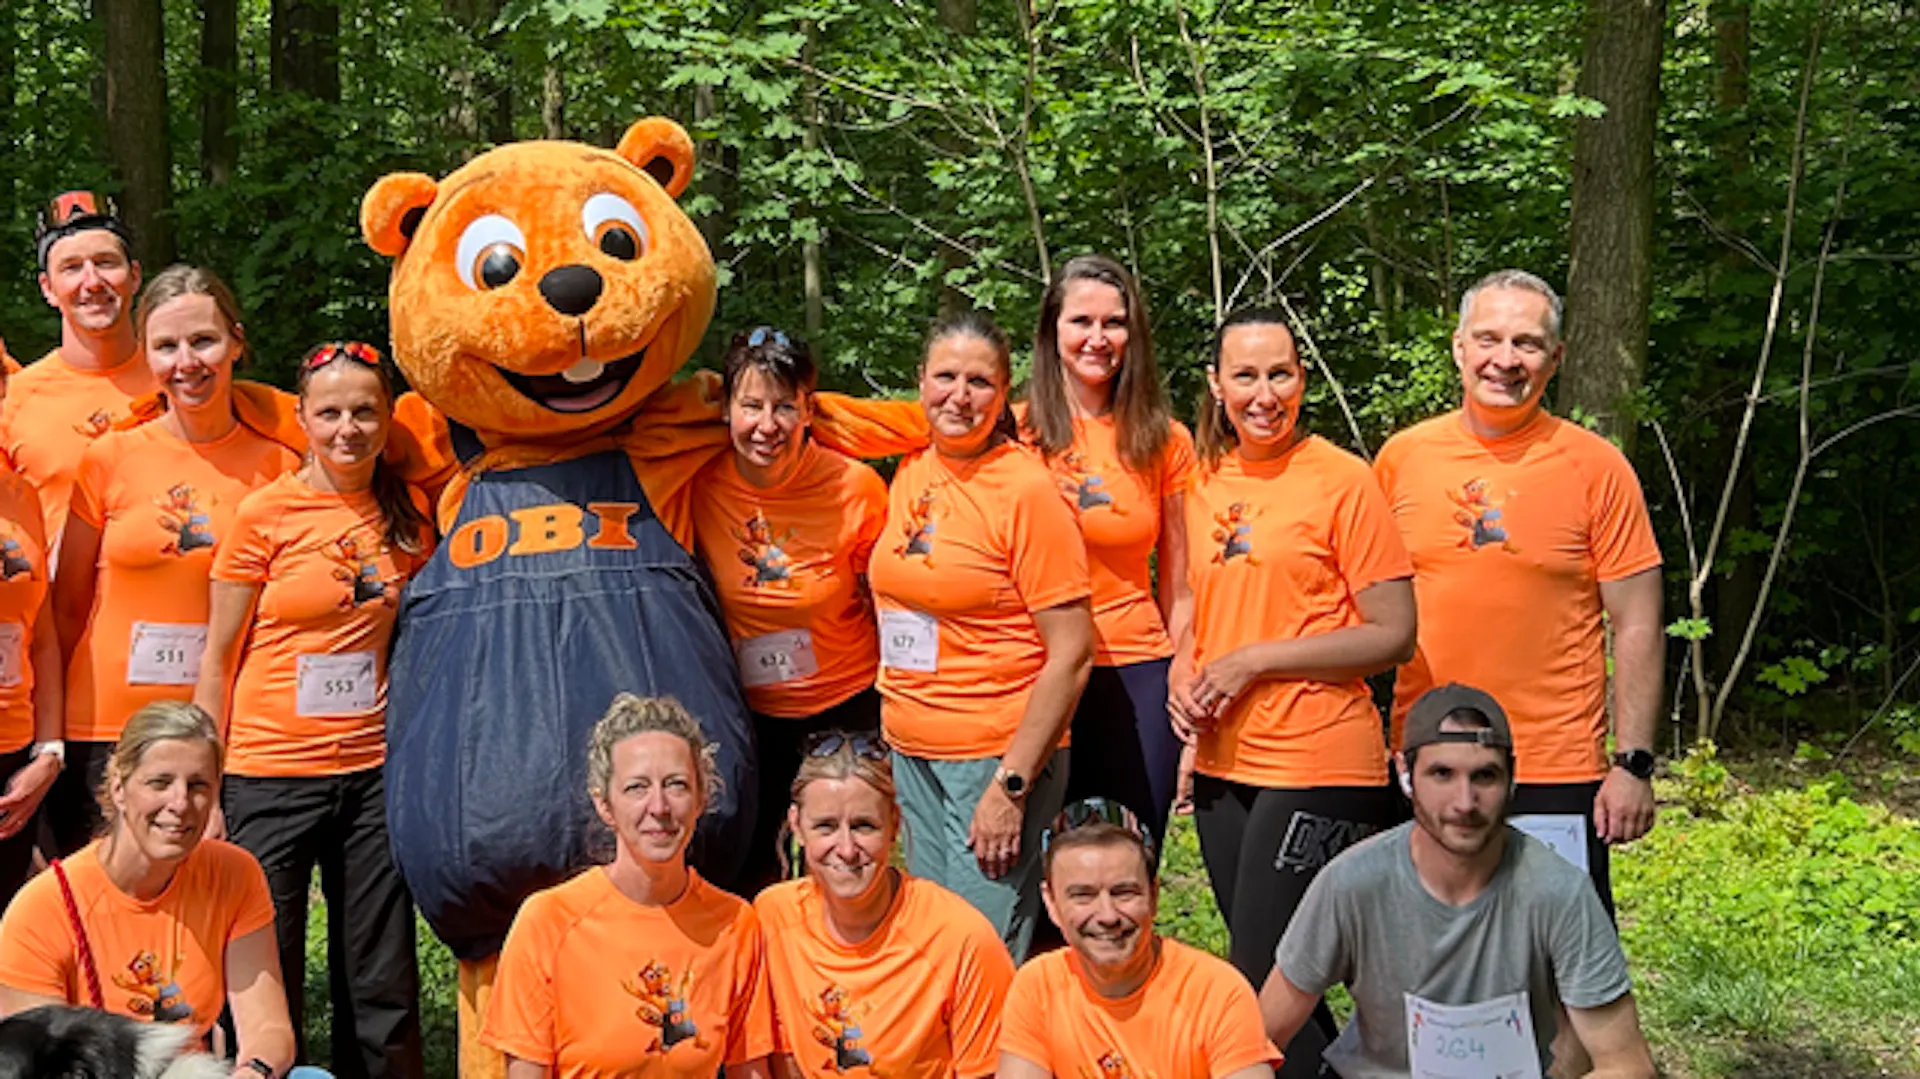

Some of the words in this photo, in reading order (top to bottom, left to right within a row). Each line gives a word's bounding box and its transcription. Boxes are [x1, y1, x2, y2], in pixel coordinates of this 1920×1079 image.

[449, 502, 640, 569] OBI
[155, 649, 184, 663] 511
[324, 679, 354, 696] 553
